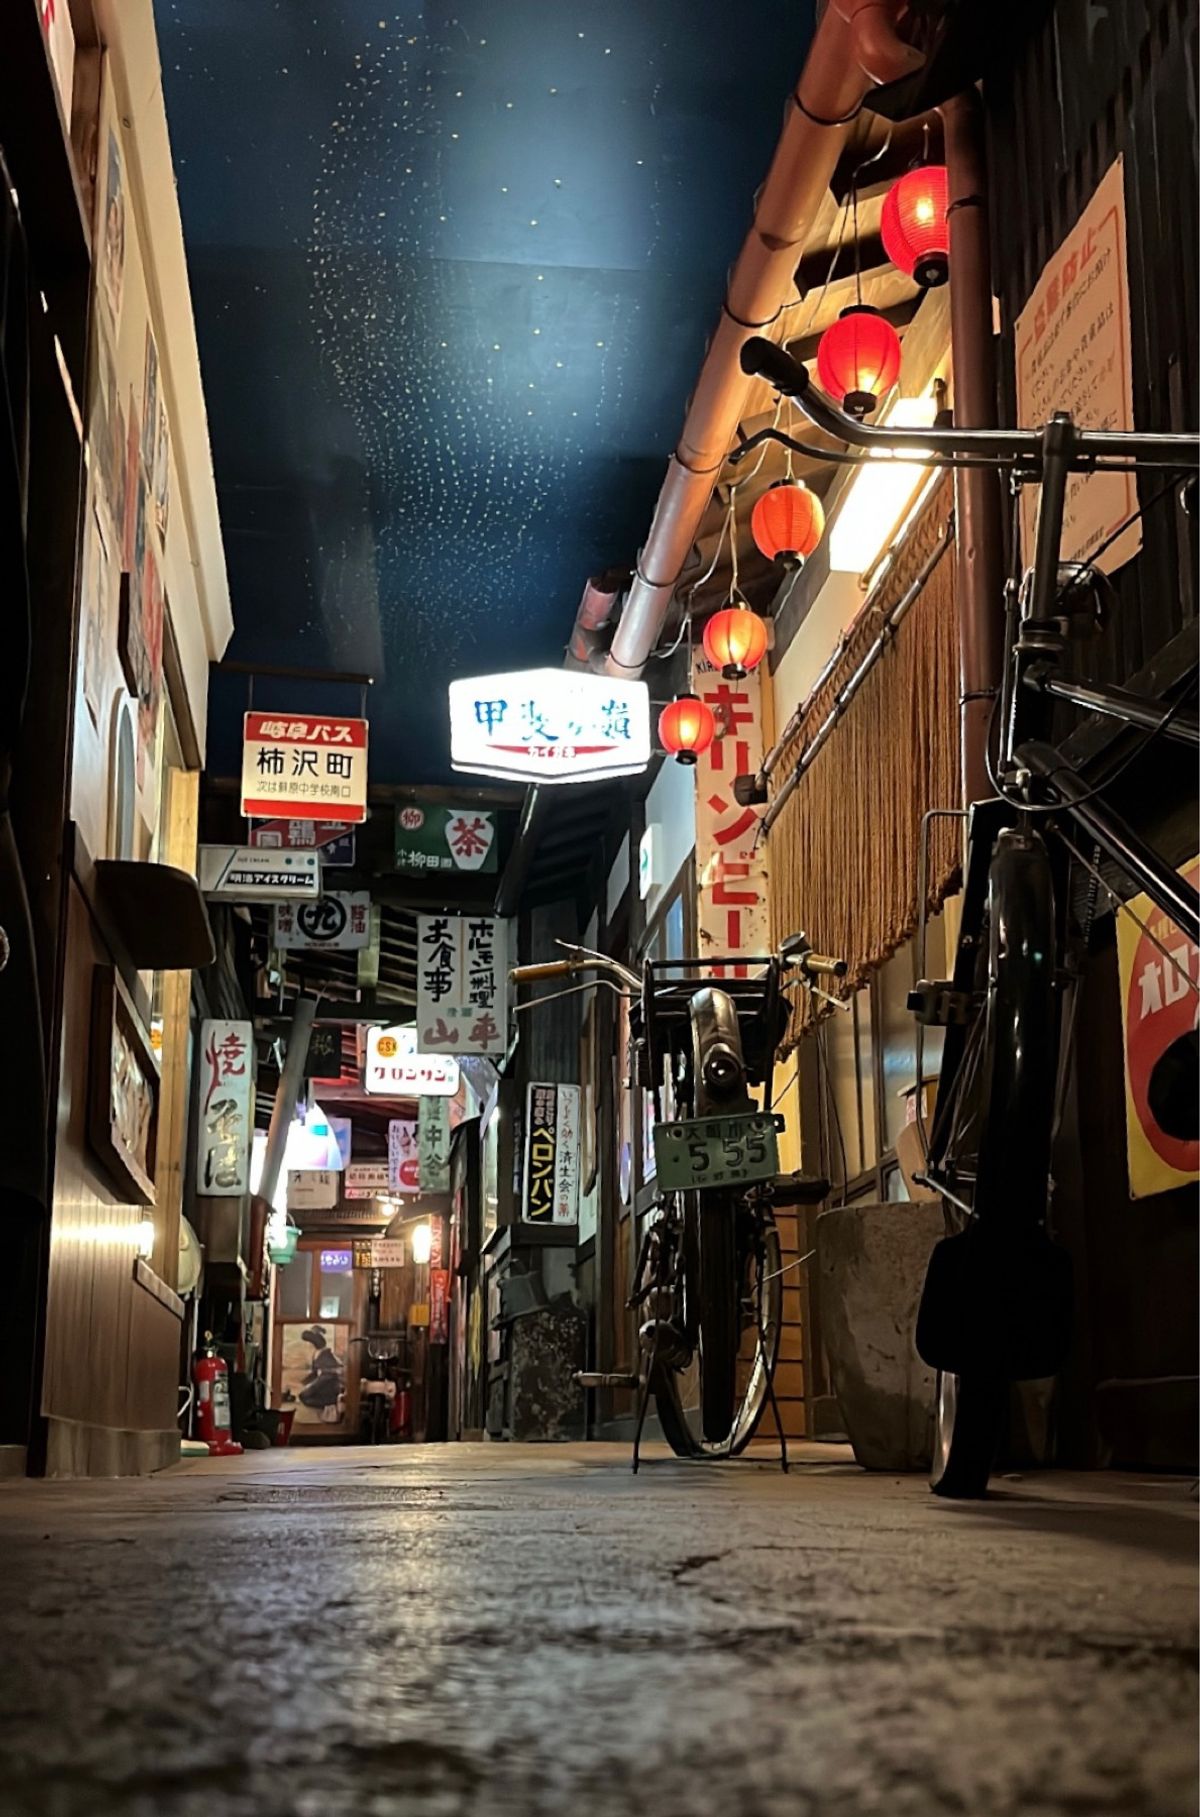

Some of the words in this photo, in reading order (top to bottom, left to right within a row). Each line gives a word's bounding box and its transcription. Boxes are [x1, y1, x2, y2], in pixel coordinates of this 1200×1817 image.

[259, 720, 353, 743] 岐阜バス
[257, 747, 353, 779] 柿沢町
[452, 817, 489, 857] 茶
[422, 918, 457, 1003] お食事
[468, 918, 498, 1009] ホルモン料理
[1138, 943, 1200, 1021] オロ
